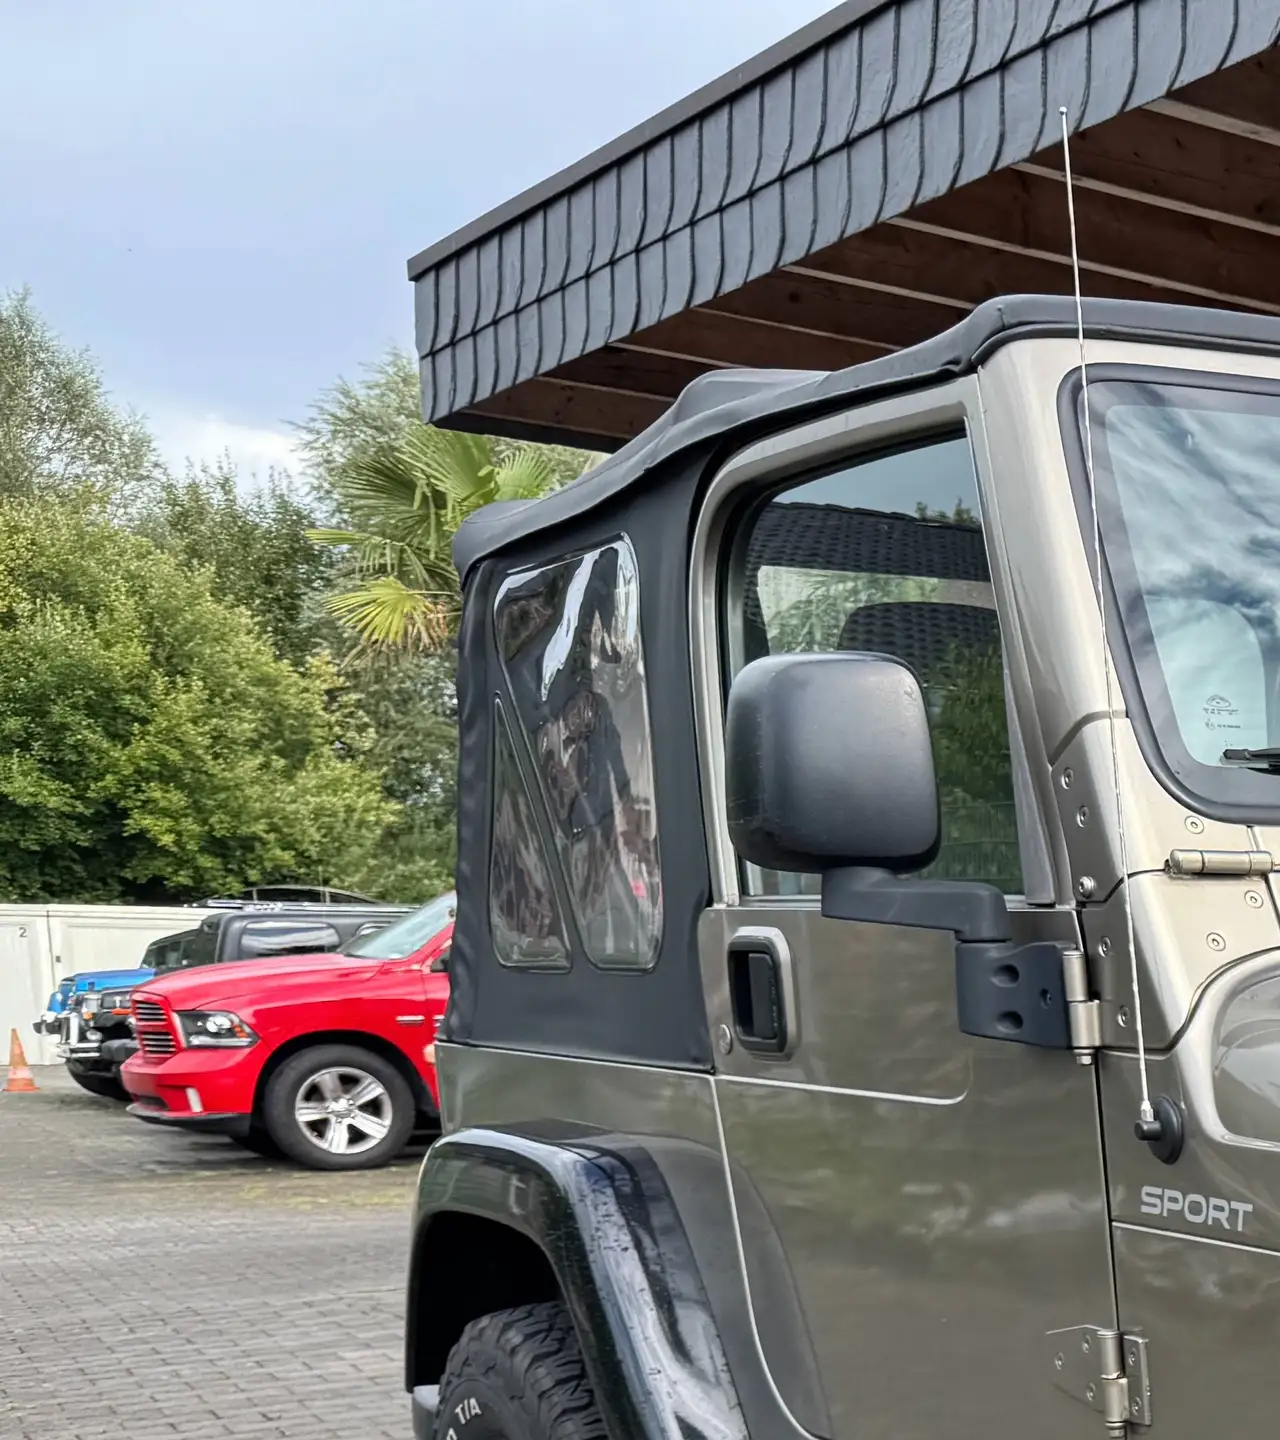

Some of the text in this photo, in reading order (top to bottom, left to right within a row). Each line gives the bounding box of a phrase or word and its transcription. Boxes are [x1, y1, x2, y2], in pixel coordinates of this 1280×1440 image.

[19, 926, 27, 938] 2
[1140, 1186, 1253, 1232] SPORT
[455, 1397, 482, 1425] T/A
